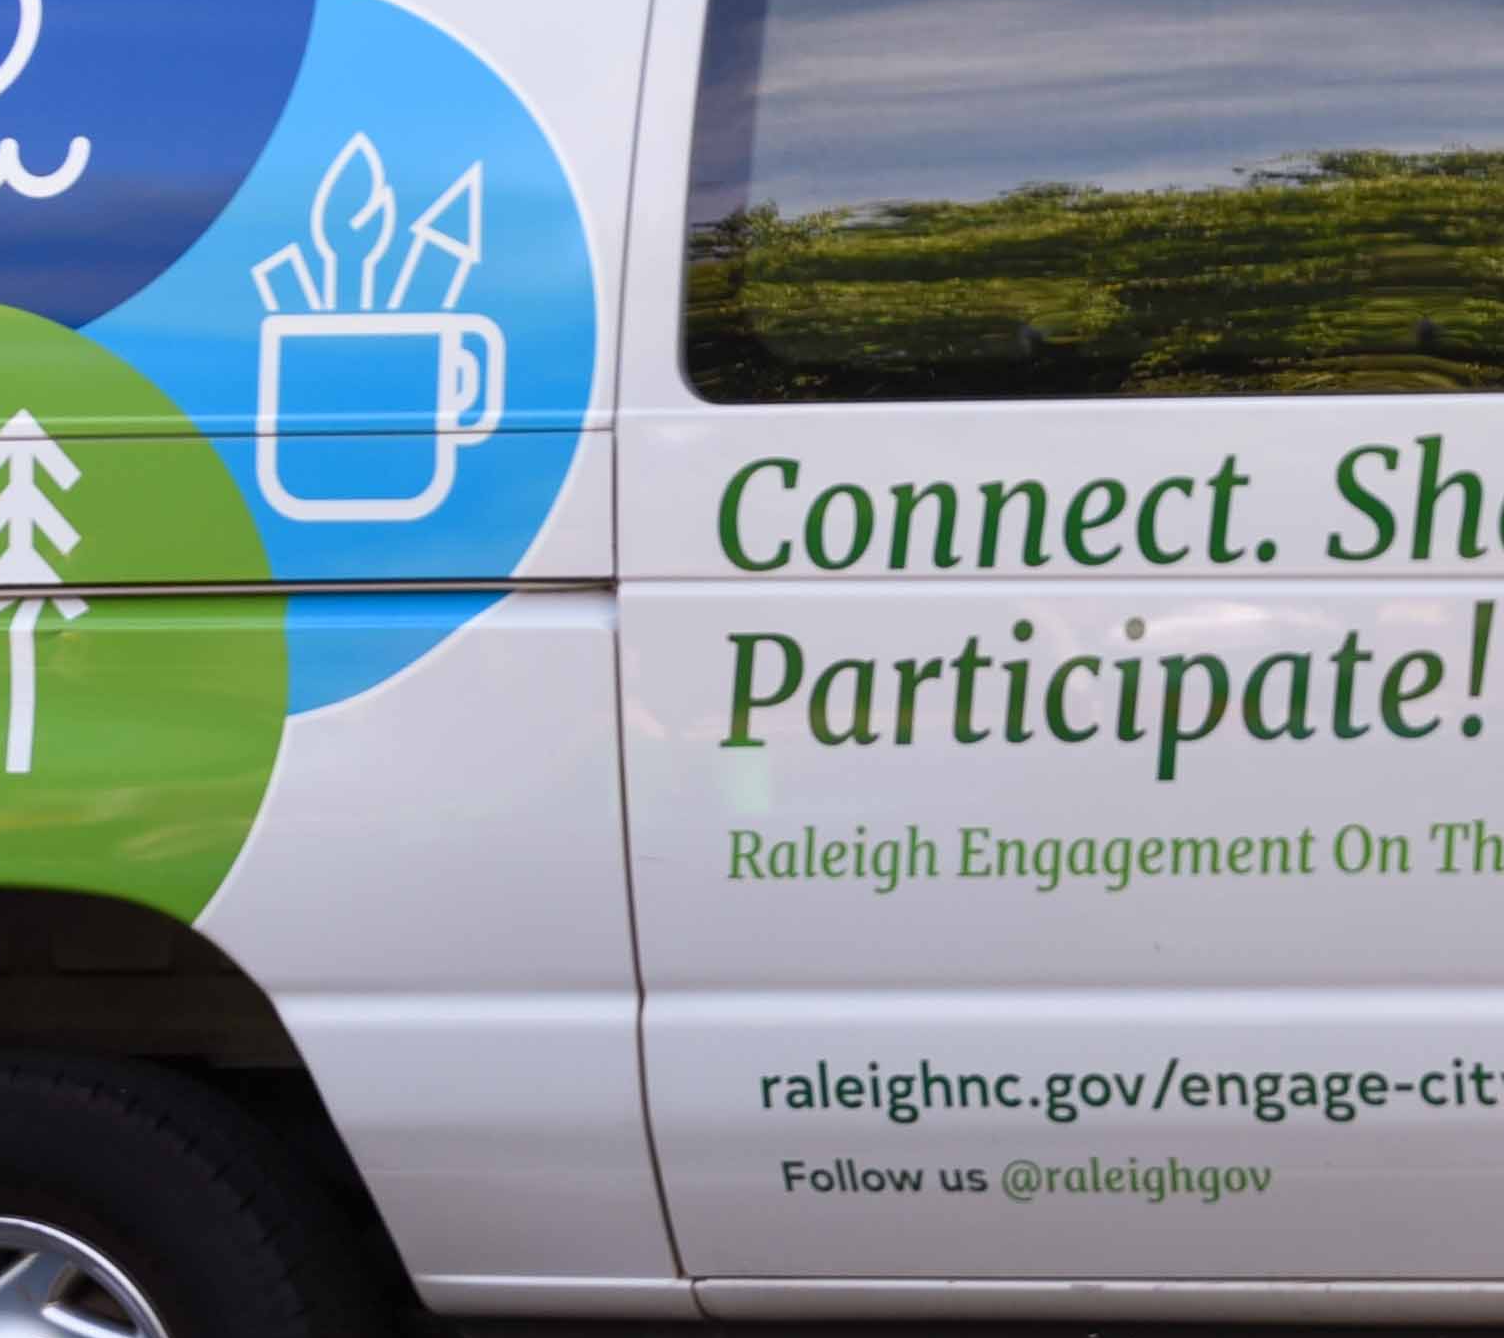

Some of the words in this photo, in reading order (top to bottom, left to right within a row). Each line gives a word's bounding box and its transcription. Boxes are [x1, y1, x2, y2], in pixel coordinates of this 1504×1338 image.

[716, 454, 1279, 573] Connect.
[718, 598, 1497, 782] Participate!
[726, 824, 940, 895] Raleigh
[956, 826, 1316, 894] Engagement
[1332, 823, 1410, 874] On
[780, 1158, 924, 1194] Follow
[939, 1169, 989, 1194] us
[999, 1156, 1272, 1205] @raleighgov
